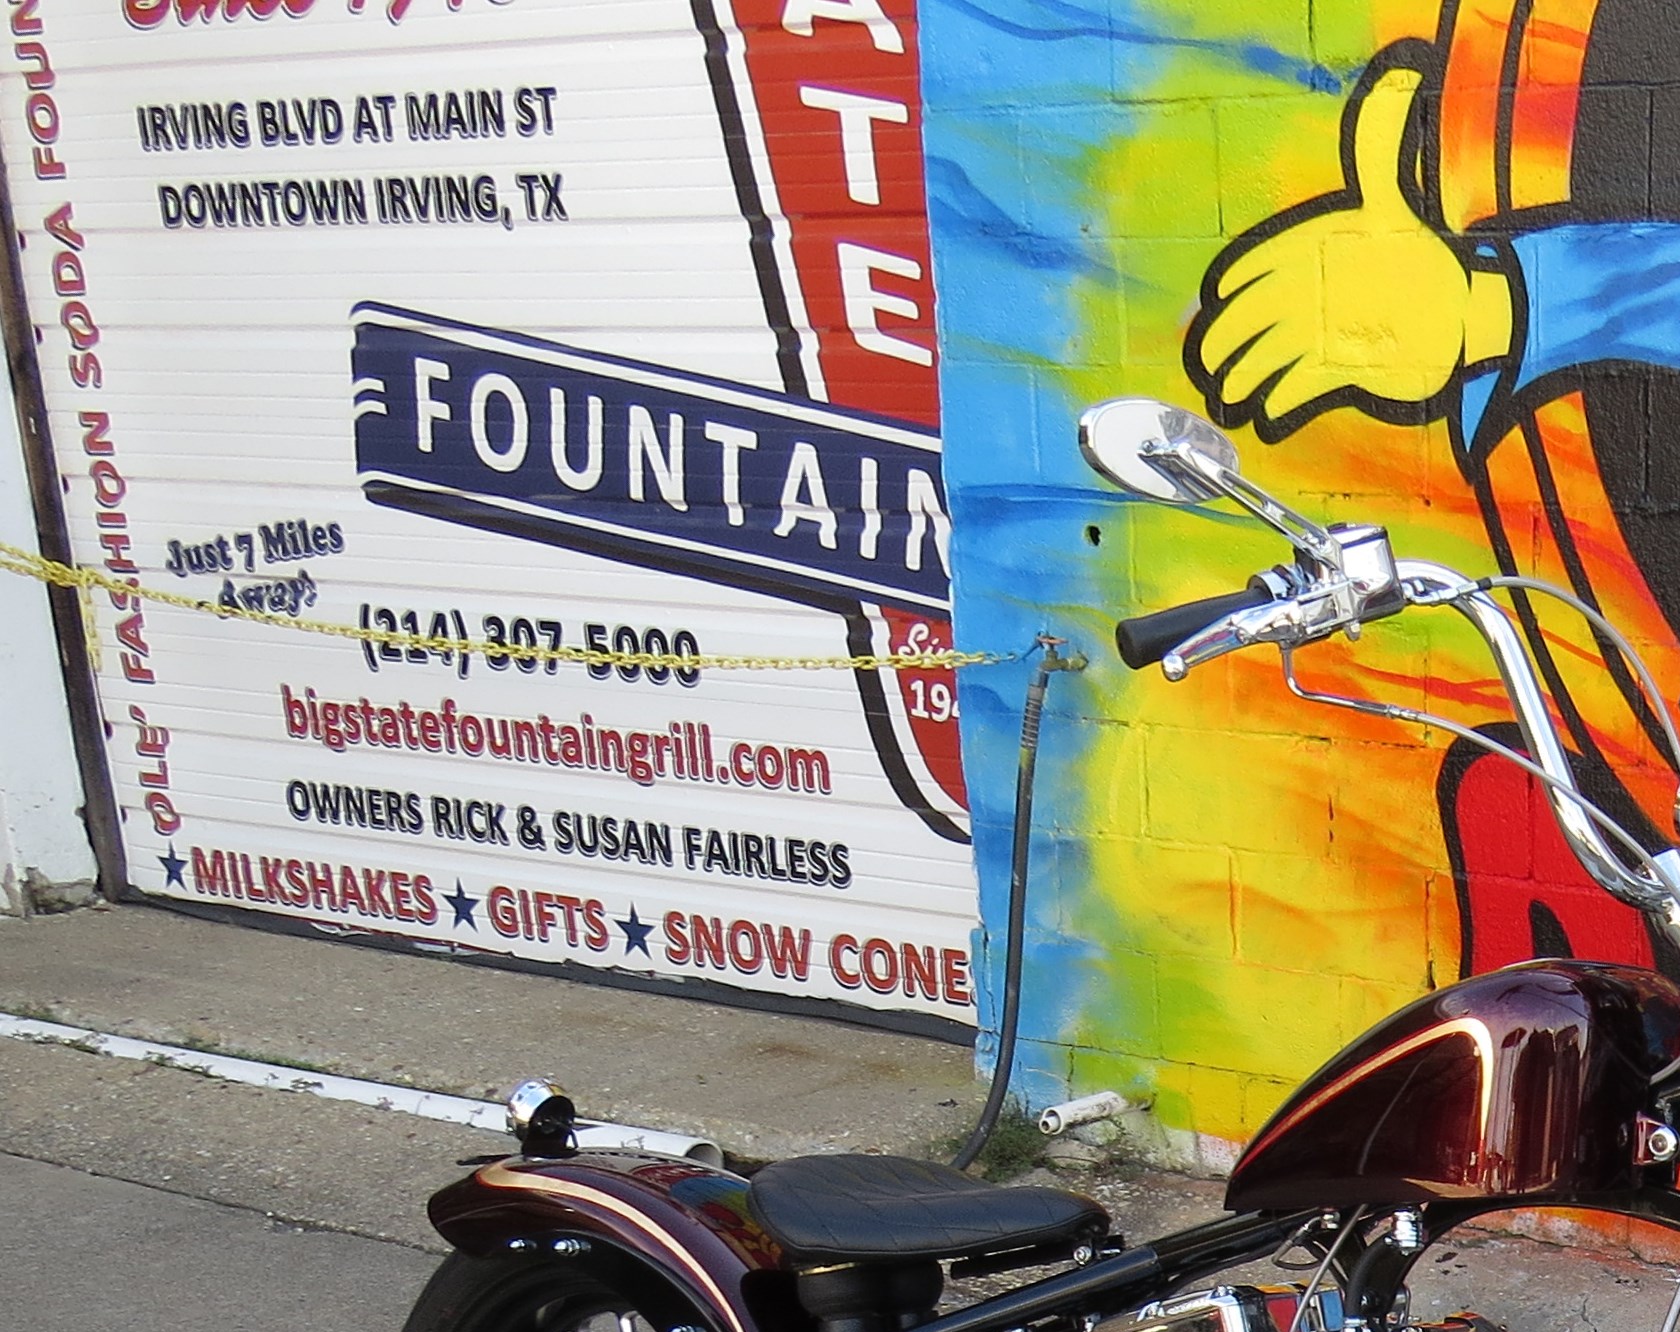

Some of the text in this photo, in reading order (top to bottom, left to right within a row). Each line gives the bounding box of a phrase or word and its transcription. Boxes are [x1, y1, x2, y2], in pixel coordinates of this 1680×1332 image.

[136, 86, 558, 151] IRVING BLVD AT MAIN ST
[157, 172, 569, 231] DOWNTOWN IRVING, TX
[45, 201, 102, 389] SODA
[414, 356, 951, 580] FOUNTAIN
[78, 411, 157, 684] FASHION
[165, 517, 346, 578] Just 7 Miles
[359, 602, 702, 689] (214) 307-5000
[281, 683, 832, 794] bigstatefountaingrill.com
[286, 778, 853, 890] OWNERS RICK & SUSAN FAIRLESS
[191, 845, 978, 1007] MILKSHAKES GIFTS SNOW CONE
